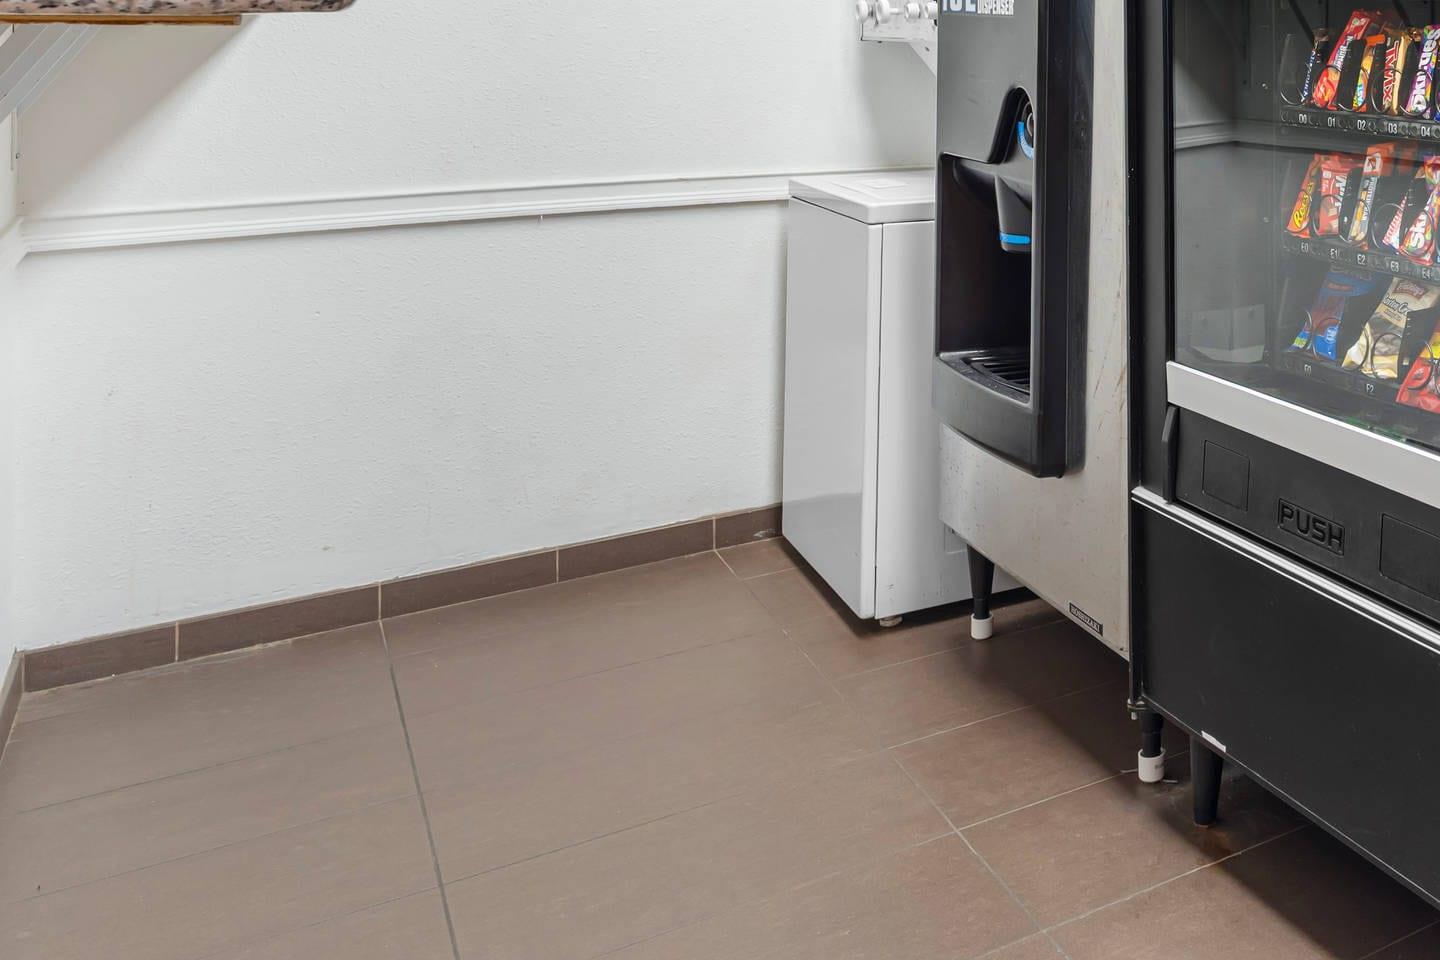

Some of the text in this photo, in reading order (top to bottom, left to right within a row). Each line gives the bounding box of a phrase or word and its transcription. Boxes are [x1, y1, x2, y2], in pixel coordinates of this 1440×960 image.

[1357, 254, 1366, 265] E2
[1390, 261, 1399, 272] E3
[1280, 503, 1343, 551] PUSH
